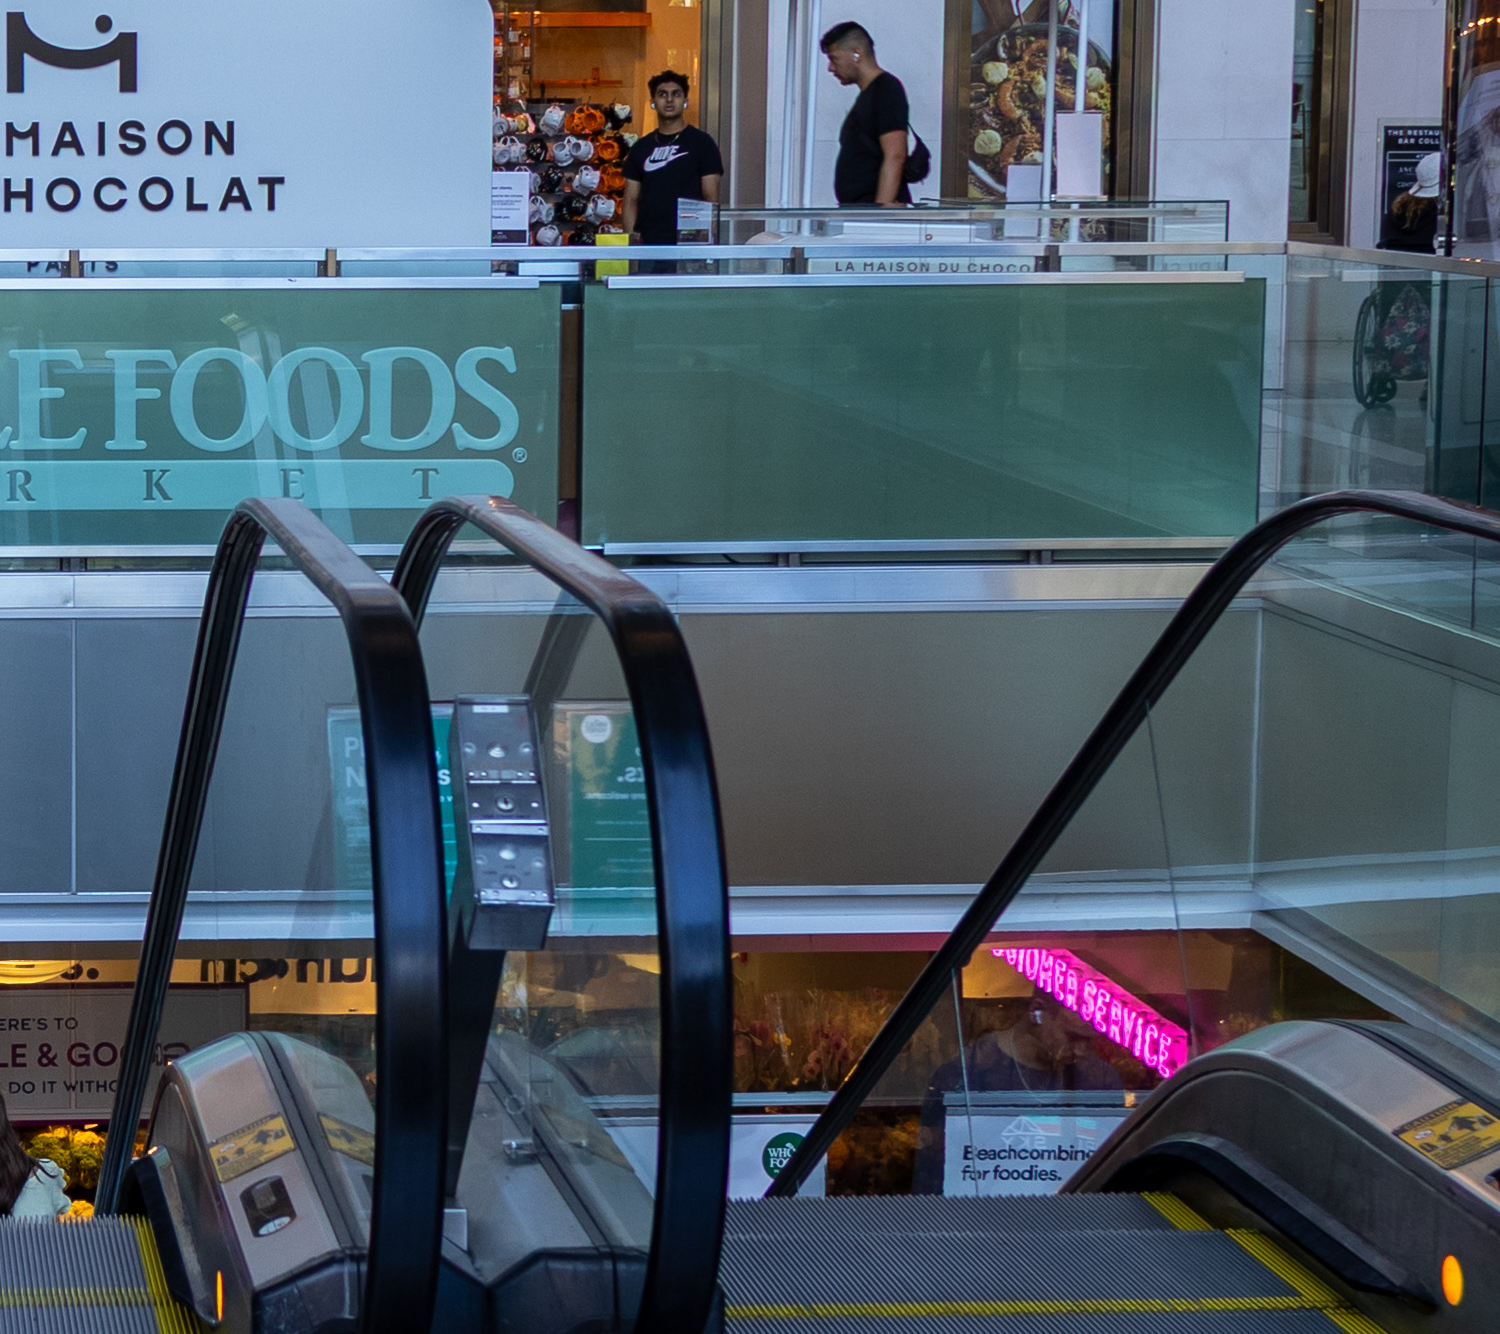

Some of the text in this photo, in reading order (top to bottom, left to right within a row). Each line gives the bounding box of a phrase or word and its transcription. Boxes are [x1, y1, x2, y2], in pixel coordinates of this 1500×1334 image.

[4, 120, 236, 157] MAISON
[26, 261, 119, 273] PAIS
[834, 261, 963, 272] LA MAISON DU
[104, 345, 520, 454] FOODS
[53, 1017, 79, 1031] TO
[1080, 979, 1173, 1079] SERVICE
[37, 1042, 58, 1069] &
[9, 1080, 36, 1095] DO
[42, 1080, 58, 1095] IT
[961, 1164, 1063, 1182] for foodies.
